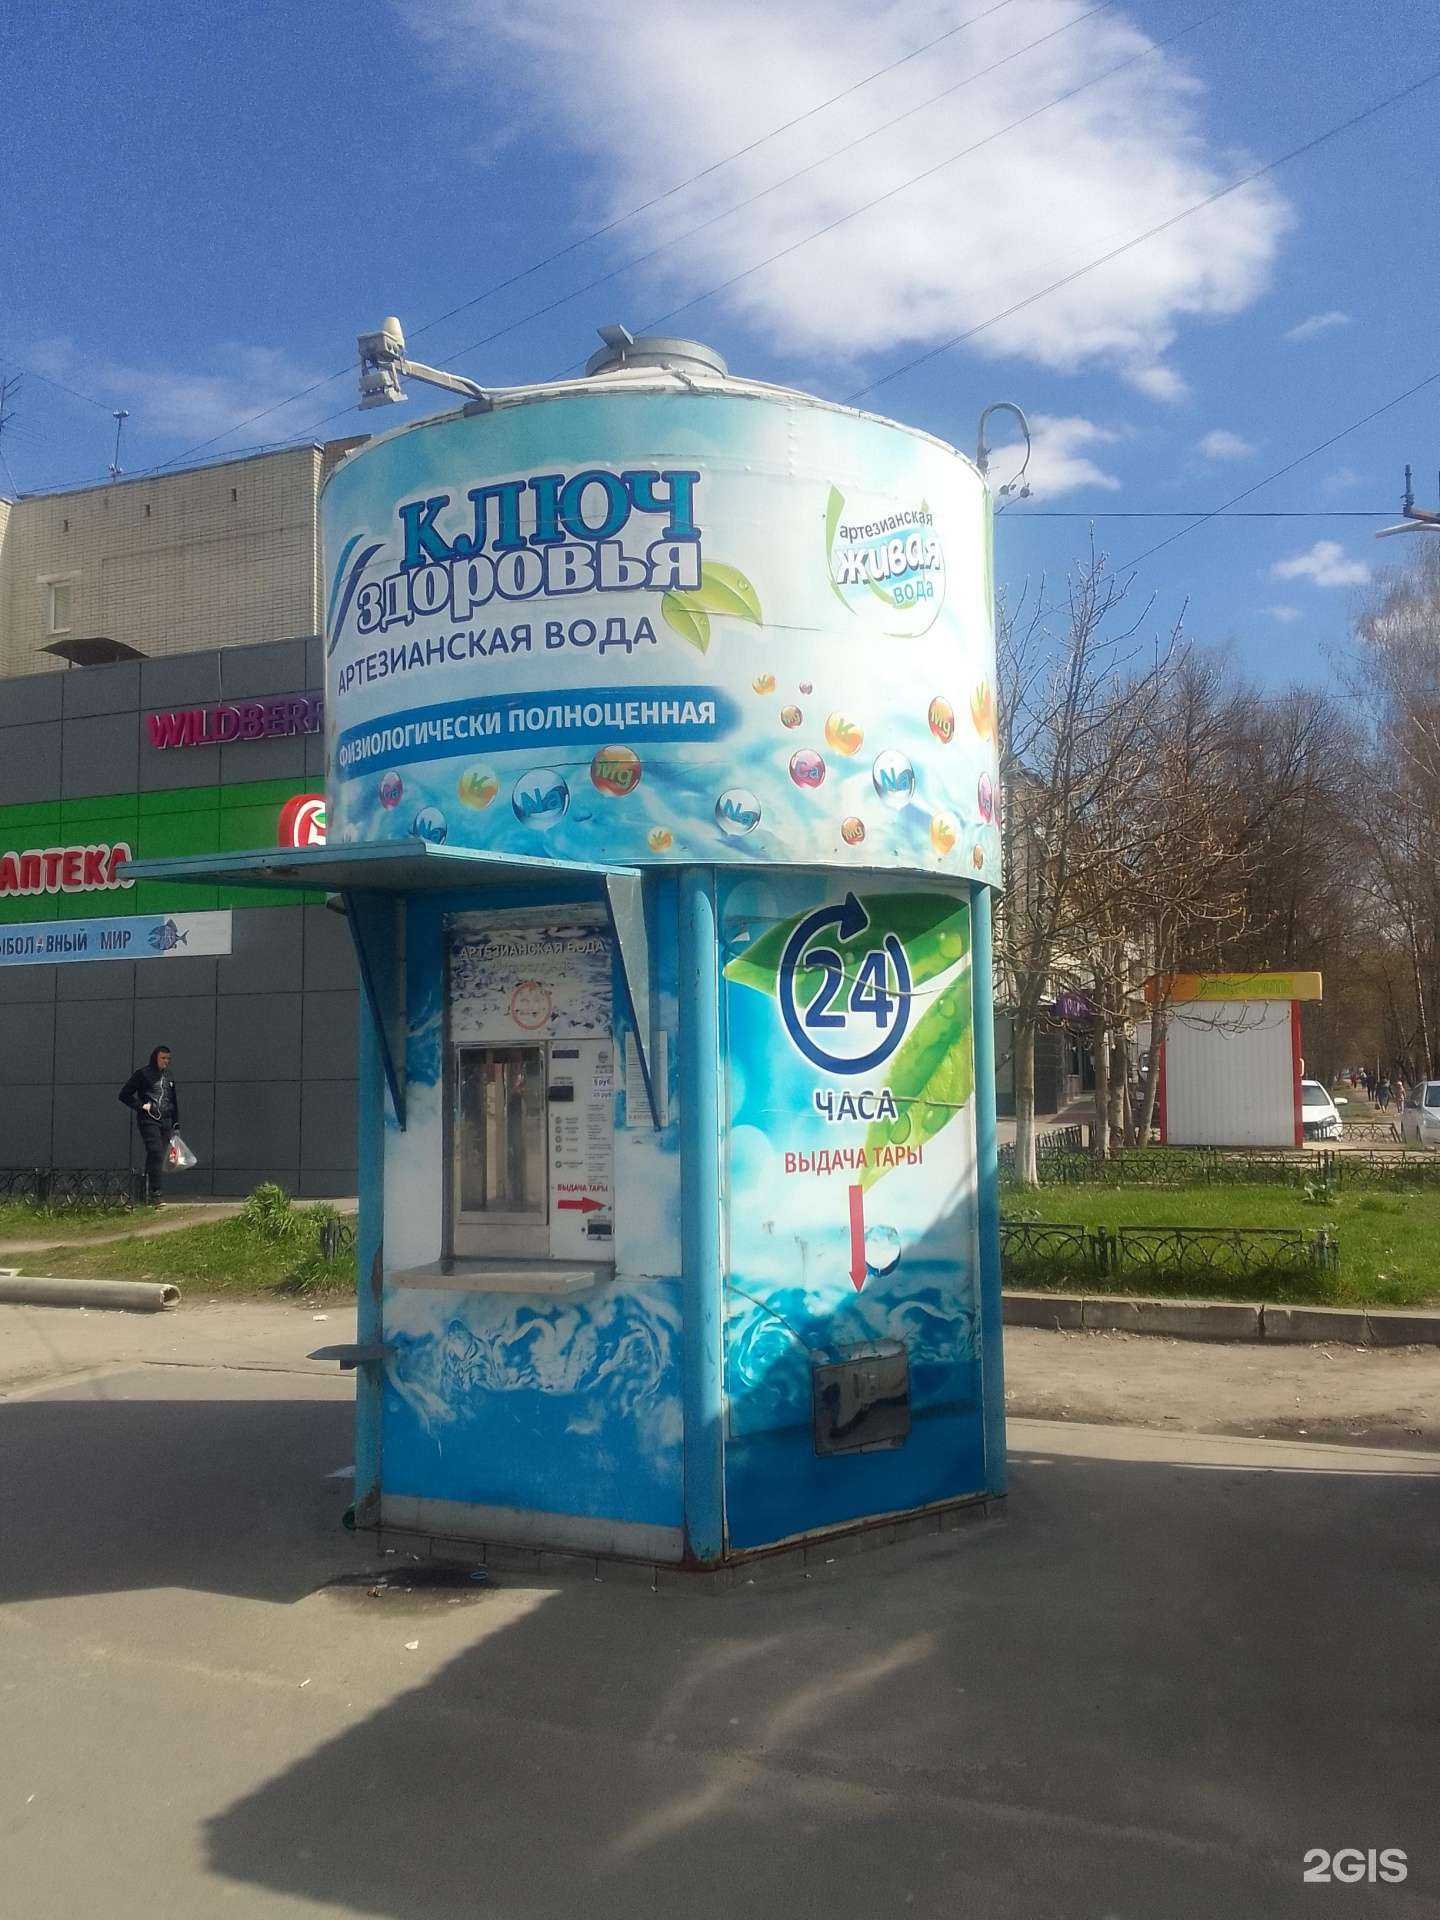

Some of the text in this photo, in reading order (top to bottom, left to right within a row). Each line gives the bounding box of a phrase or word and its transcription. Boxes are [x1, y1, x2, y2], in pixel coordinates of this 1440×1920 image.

[399, 470, 702, 571] КЛЮЧ
[839, 511, 933, 544] артезианская
[893, 581, 934, 605] вода
[338, 616, 658, 696] АРТЕЗИАНСКАЯ ВОДА
[339, 701, 716, 768] ФИЗИОЛОГИЧЕСКИ ПОЛНОЦЕННАЯ
[0, 846, 134, 895] АПТЕКА
[100, 929, 132, 950] МИР
[805, 950, 893, 1029] 24
[814, 1088, 898, 1121] ЧАСА
[784, 1143, 924, 1175] ВЫДАЧА ТАРЫ
